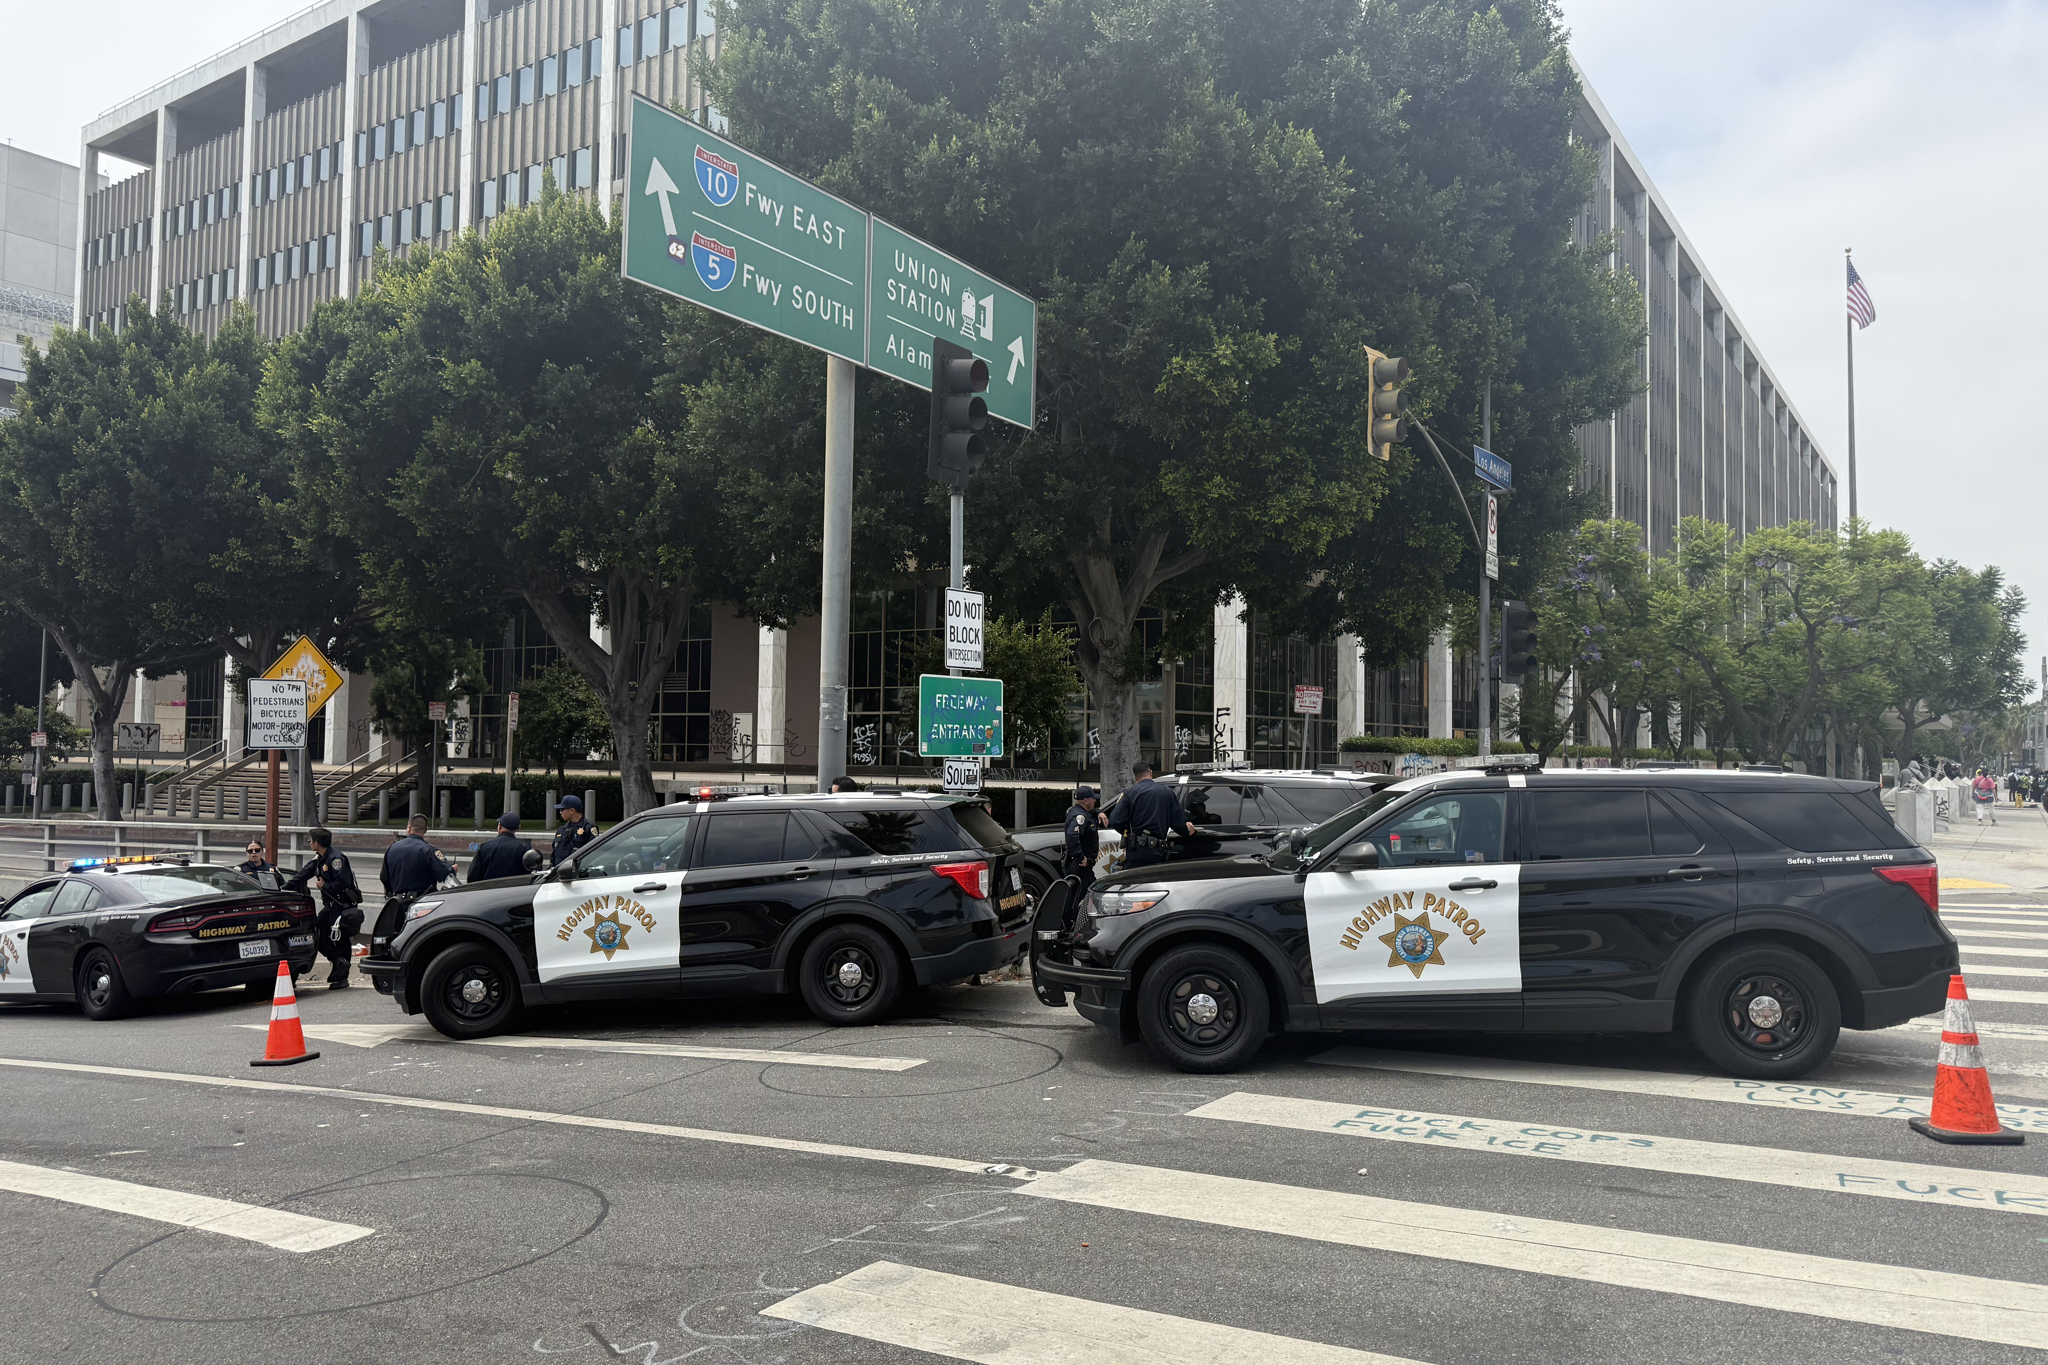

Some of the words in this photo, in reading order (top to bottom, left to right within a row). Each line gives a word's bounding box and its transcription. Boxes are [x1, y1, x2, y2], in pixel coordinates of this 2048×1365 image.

[701, 152, 732, 172] INTERSTATE
[707, 167, 728, 198] 10
[745, 181, 784, 227] Fwy
[793, 205, 846, 250] EAST
[668, 242, 686, 259] 62
[699, 238, 730, 256] INTERSTATE
[708, 254, 720, 281] 5
[894, 249, 950, 297] UNION
[742, 263, 782, 306] Fwy
[792, 285, 853, 330] SOUTH
[886, 278, 956, 329] STATION
[886, 334, 932, 371] Alam
[1476, 452, 1488, 471] Los
[1488, 458, 1510, 483] Angeles
[948, 599, 961, 618] DO
[964, 601, 982, 620] NOT
[950, 625, 980, 646] BLOCK
[948, 648, 982, 663] INTERSECTION
[272, 685, 285, 694] NO
[287, 684, 301, 692] TPH
[1296, 690, 1304, 699] NO
[253, 697, 304, 706] PEDESTRIANS
[936, 694, 988, 711] FREEWAY
[260, 710, 298, 718] BICYCLES
[252, 722, 306, 730] MOTOR-DRIVEN
[854, 723, 877, 740] ICE
[263, 734, 292, 743] CYCLES
[1787, 857, 1814, 865] Safety,
[1862, 853, 1894, 861] Security
[556, 894, 610, 942] HIGHWAY
[615, 896, 658, 934] PATROL
[1339, 891, 1414, 950] HIGHWAY
[1422, 892, 1486, 946] PATROL
[198, 925, 248, 938] HIGHWAY
[257, 920, 290, 932] PATROL
[3, 934, 20, 964] PATROL
[242, 945, 268, 958] 1540392
[1746, 1090, 1858, 1111] LOS
[1332, 1120, 1460, 1142] FUCK
[1488, 1136, 1568, 1155] ICE
[1354, 1110, 1490, 1132] FUCK
[1519, 1128, 1656, 1148] COPS
[1836, 1173, 2048, 1210] FUCK
